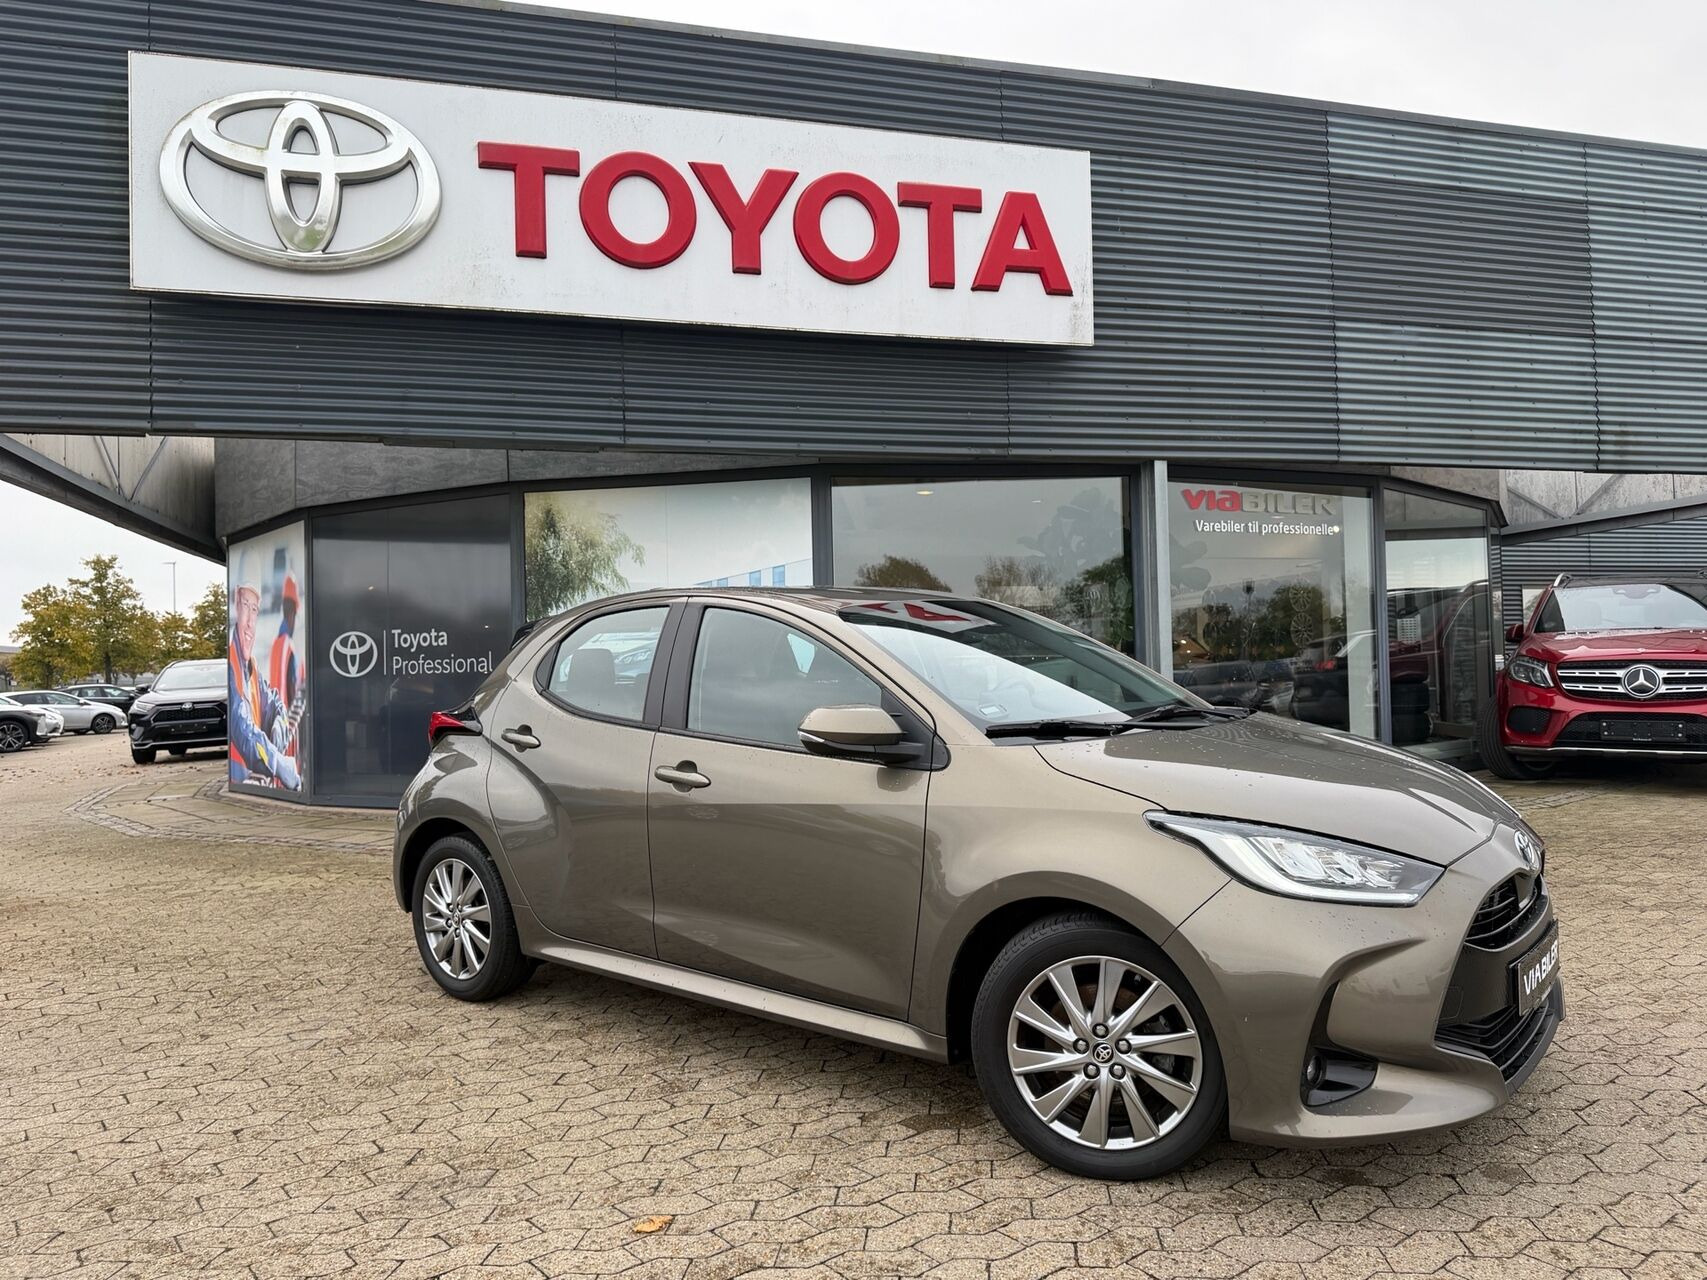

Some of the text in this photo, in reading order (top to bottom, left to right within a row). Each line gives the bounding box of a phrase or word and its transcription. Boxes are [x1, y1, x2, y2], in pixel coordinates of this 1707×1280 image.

[477, 140, 1074, 297] TOYOTA
[1195, 519, 1334, 536] Varebiler til professionelle
[391, 628, 448, 652] Toyota
[392, 651, 493, 676] Professional
